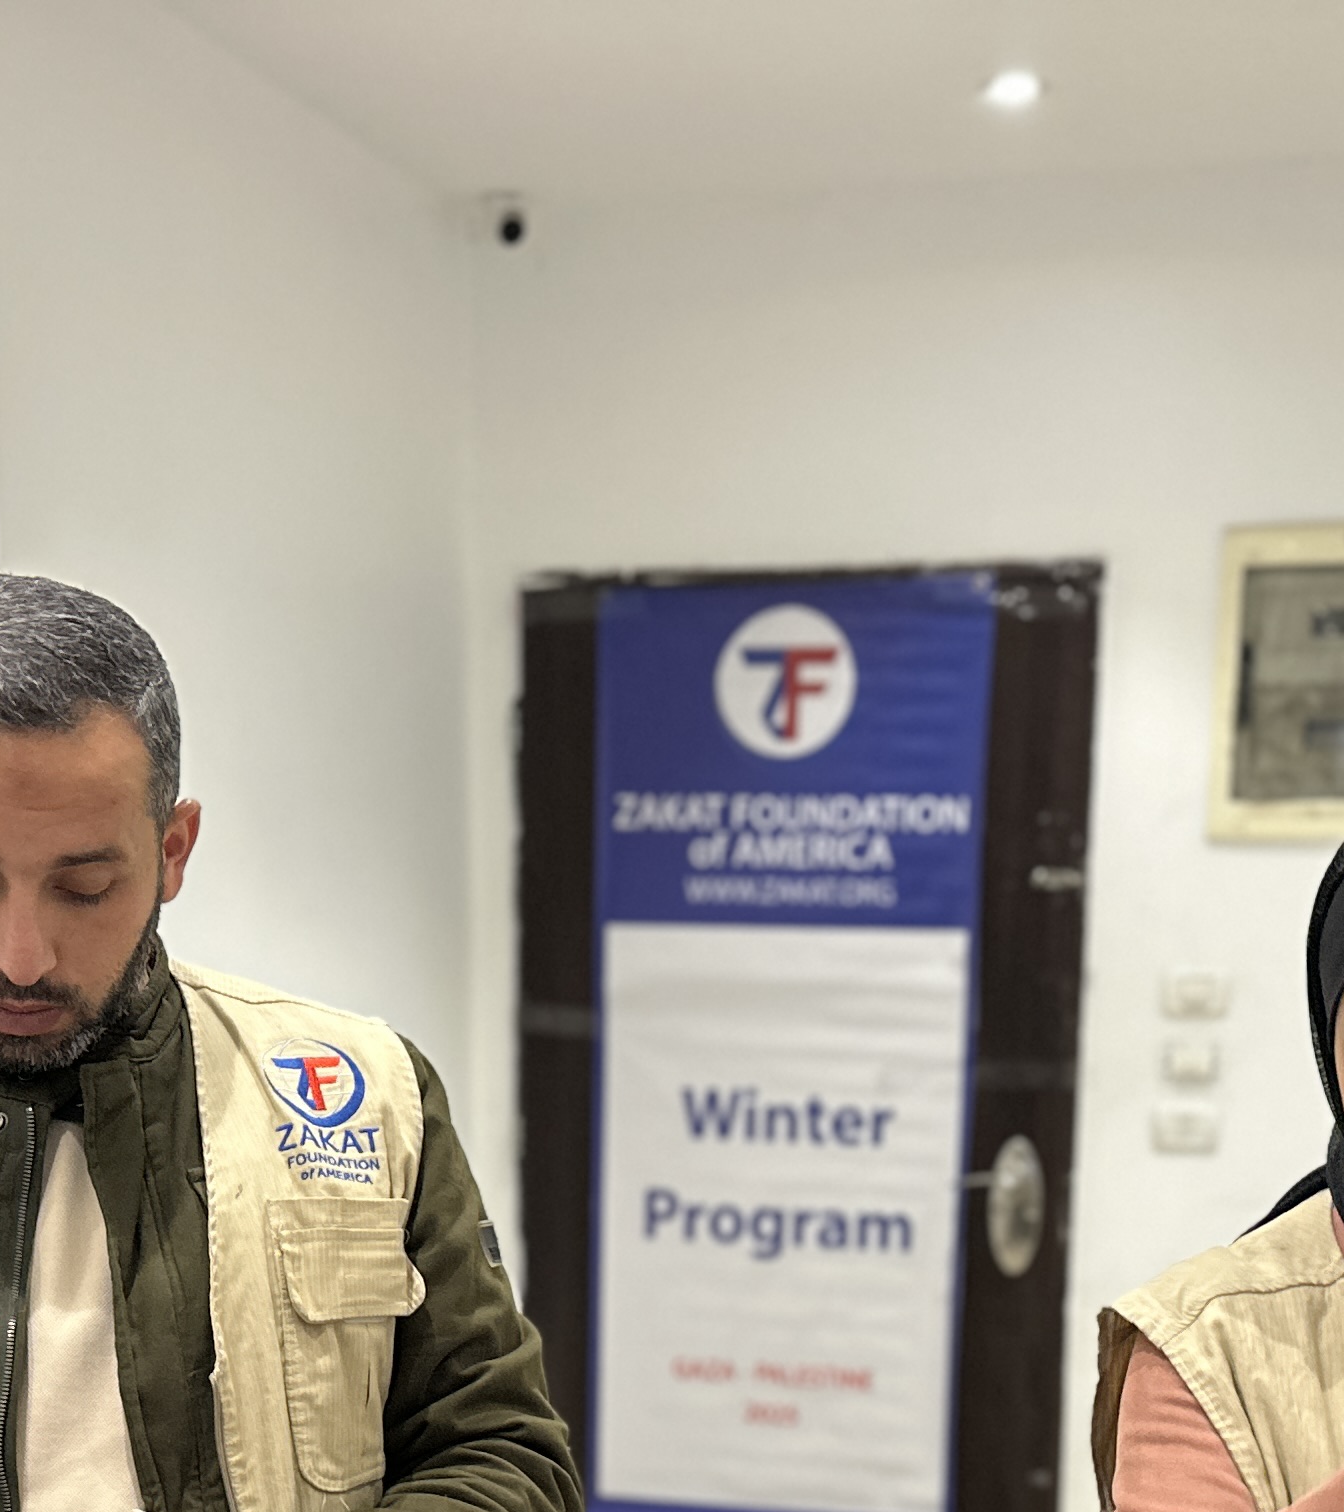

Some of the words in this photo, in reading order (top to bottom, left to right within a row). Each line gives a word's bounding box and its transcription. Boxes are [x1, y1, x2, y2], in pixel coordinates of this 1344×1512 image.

[613, 792, 727, 832] ZAKAT
[730, 792, 972, 834] FOUNDATION
[687, 831, 729, 869] of
[732, 832, 894, 870] AMERICA
[682, 1087, 894, 1145] Winter
[276, 1123, 379, 1153] ZAKAT
[287, 1152, 380, 1170] FOUNDATION
[301, 1168, 314, 1180] of
[318, 1169, 373, 1184] AMERICA
[644, 1188, 912, 1259] Program
